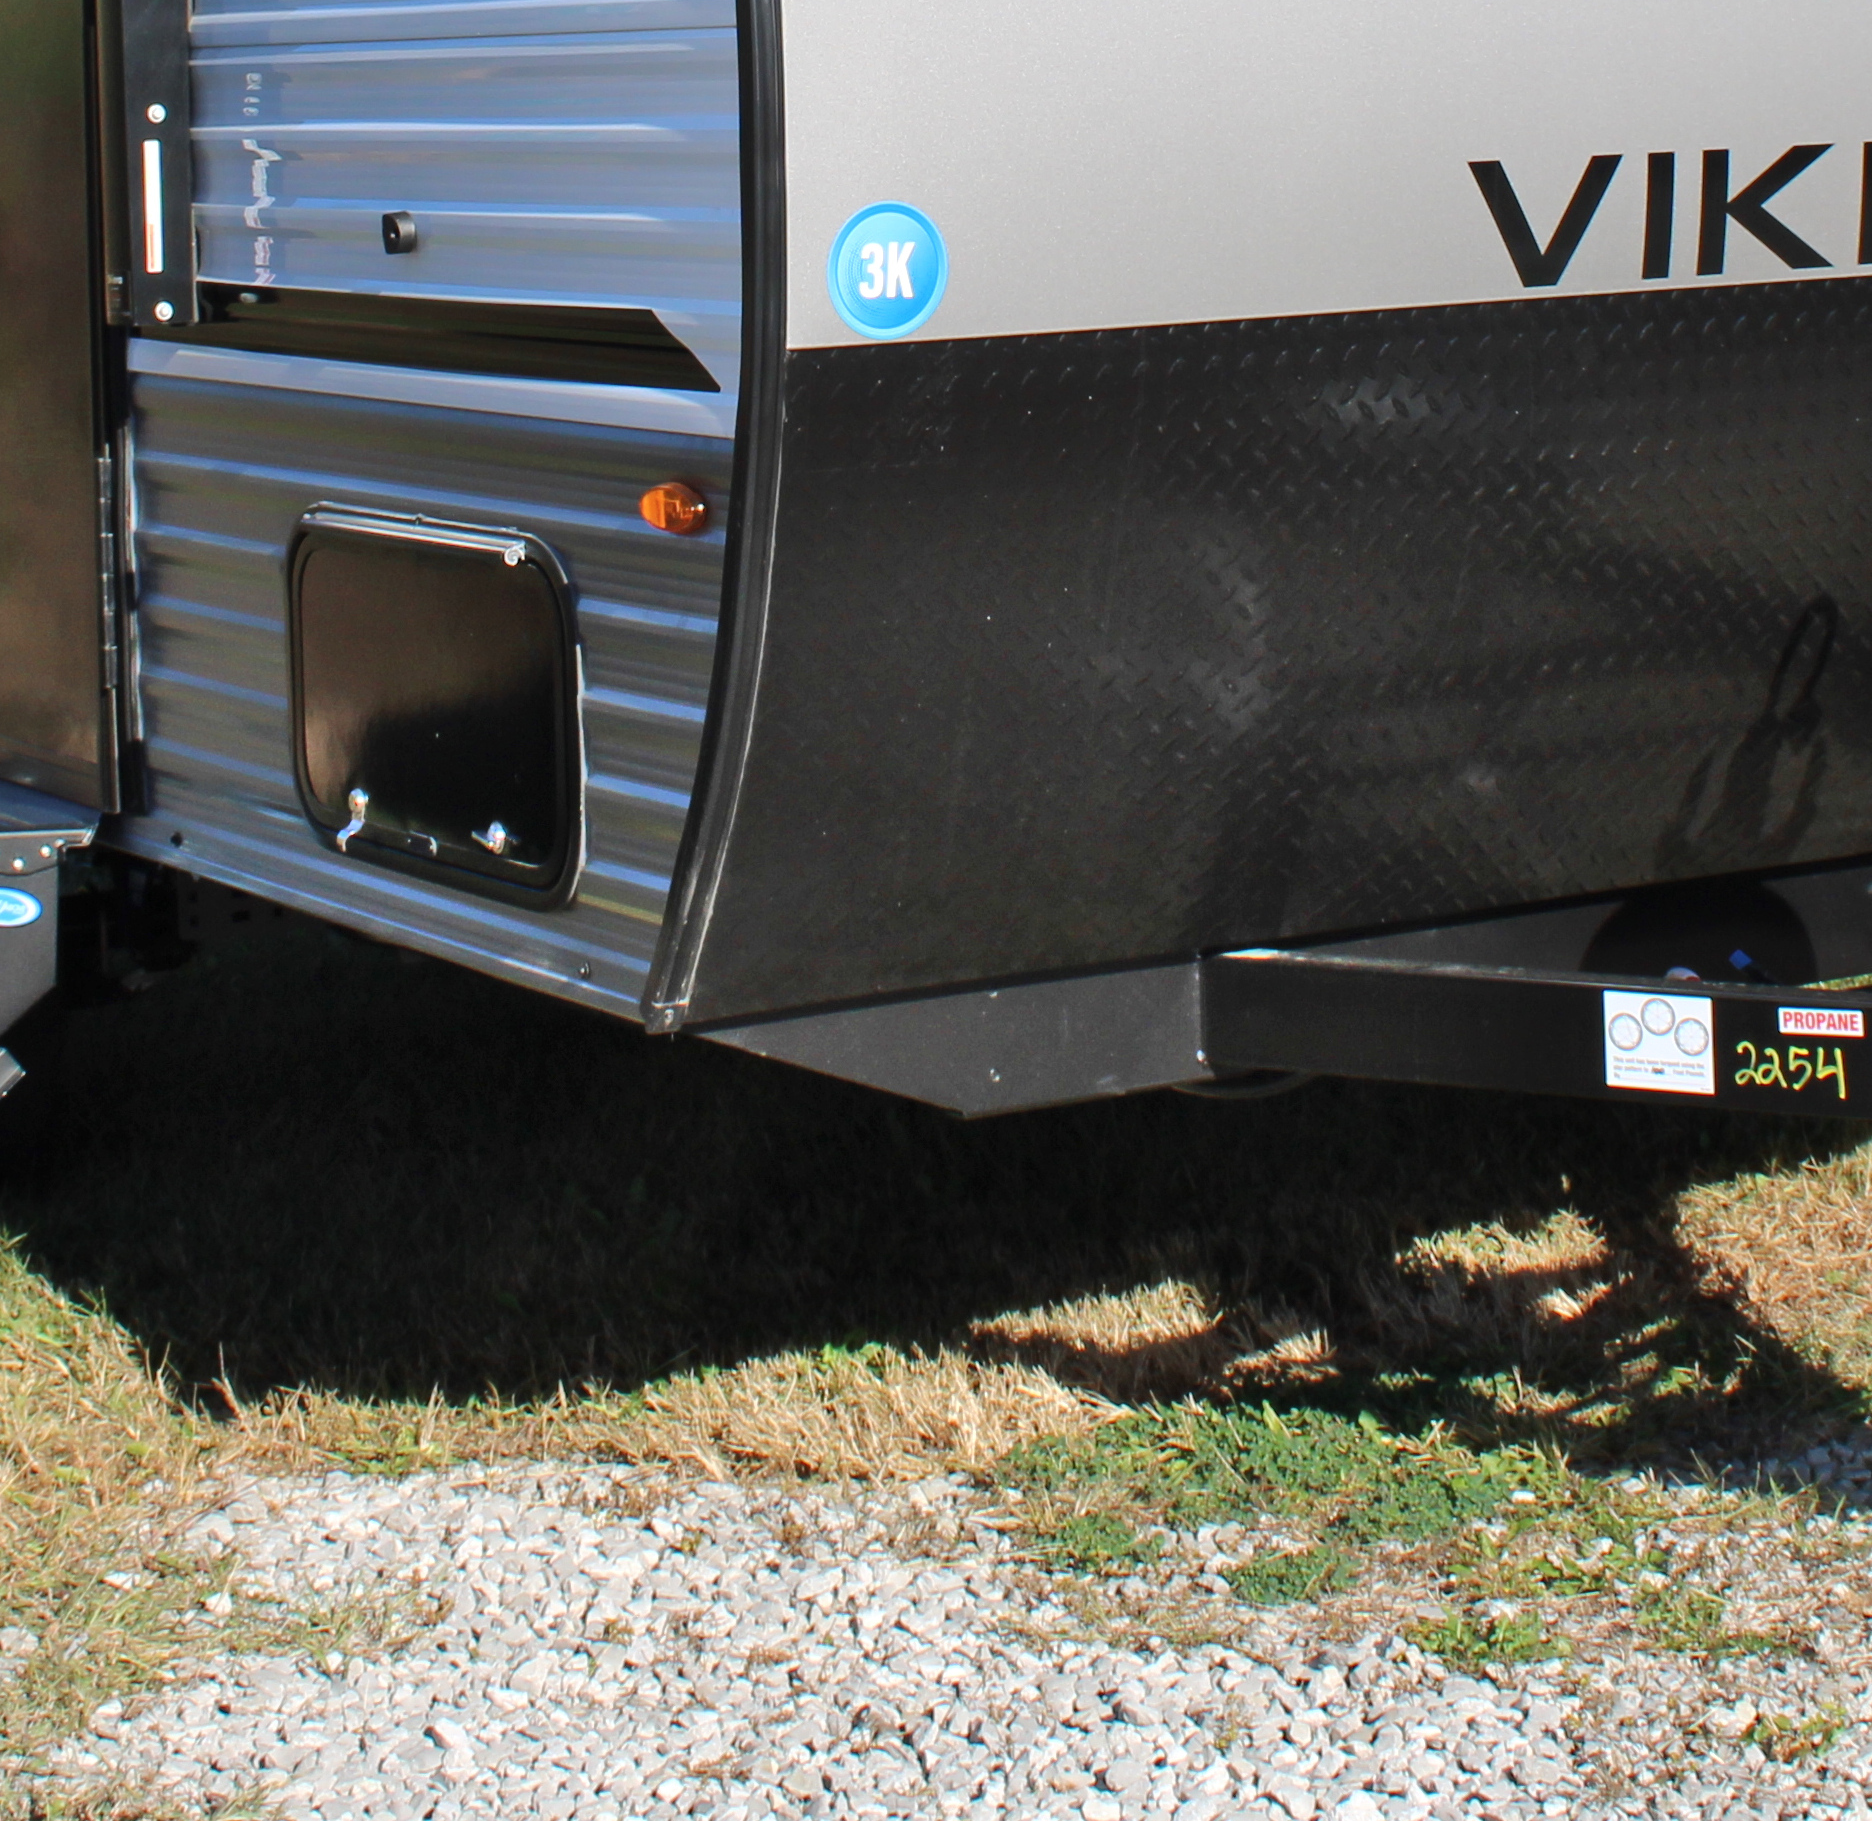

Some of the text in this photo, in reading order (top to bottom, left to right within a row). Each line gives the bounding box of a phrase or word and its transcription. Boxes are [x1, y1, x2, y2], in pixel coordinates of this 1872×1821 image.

[858, 241, 916, 299] 3K
[1782, 1011, 1860, 1033] PROPANE
[1734, 1041, 1847, 1100] 2254
